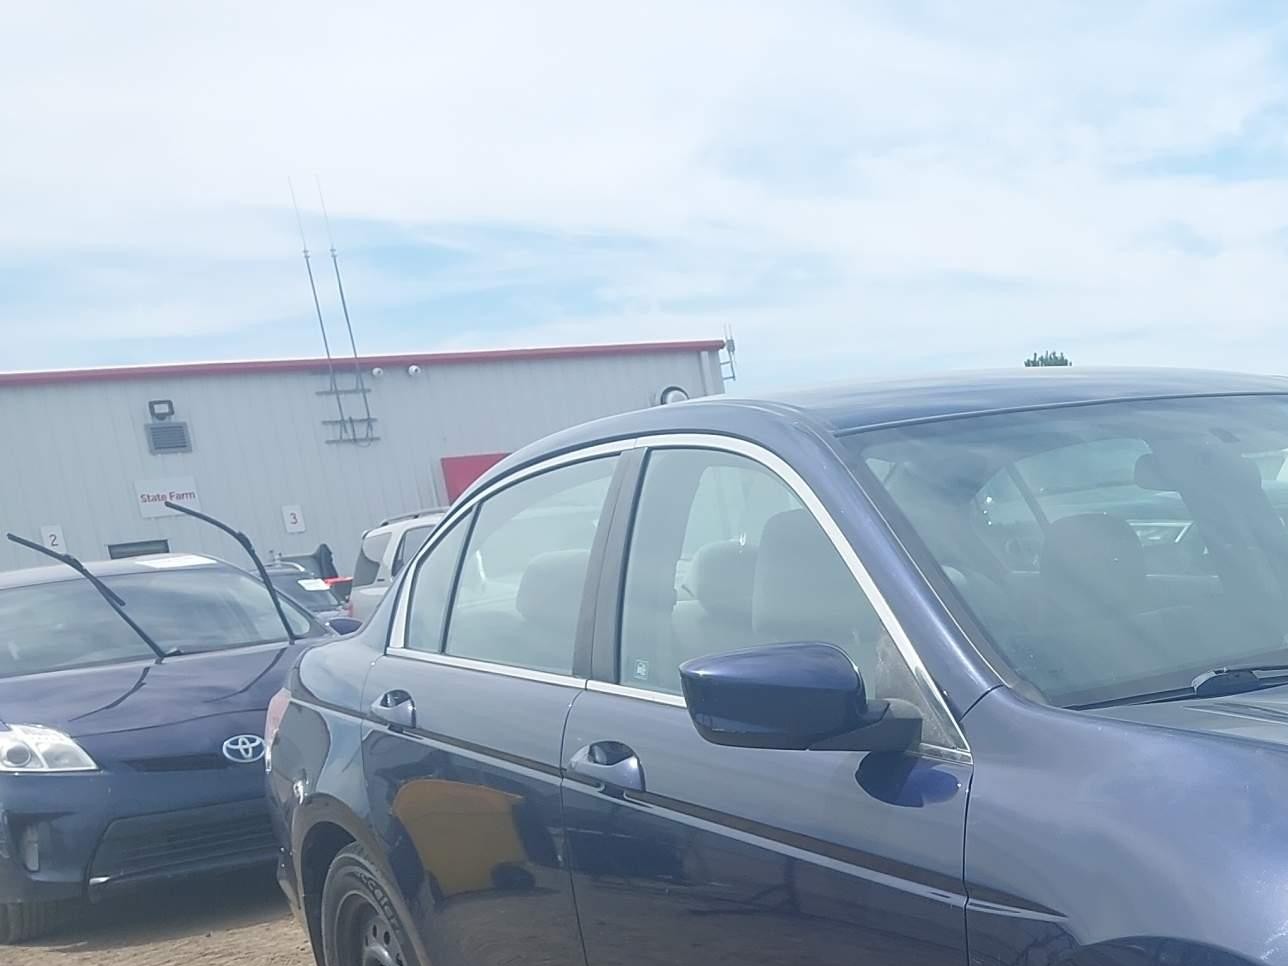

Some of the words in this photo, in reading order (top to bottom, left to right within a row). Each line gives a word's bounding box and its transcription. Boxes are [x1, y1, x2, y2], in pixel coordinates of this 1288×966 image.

[140, 492, 167, 504] State
[169, 491, 196, 502] Farm
[289, 513, 298, 525] 3
[48, 535, 58, 547] 2
